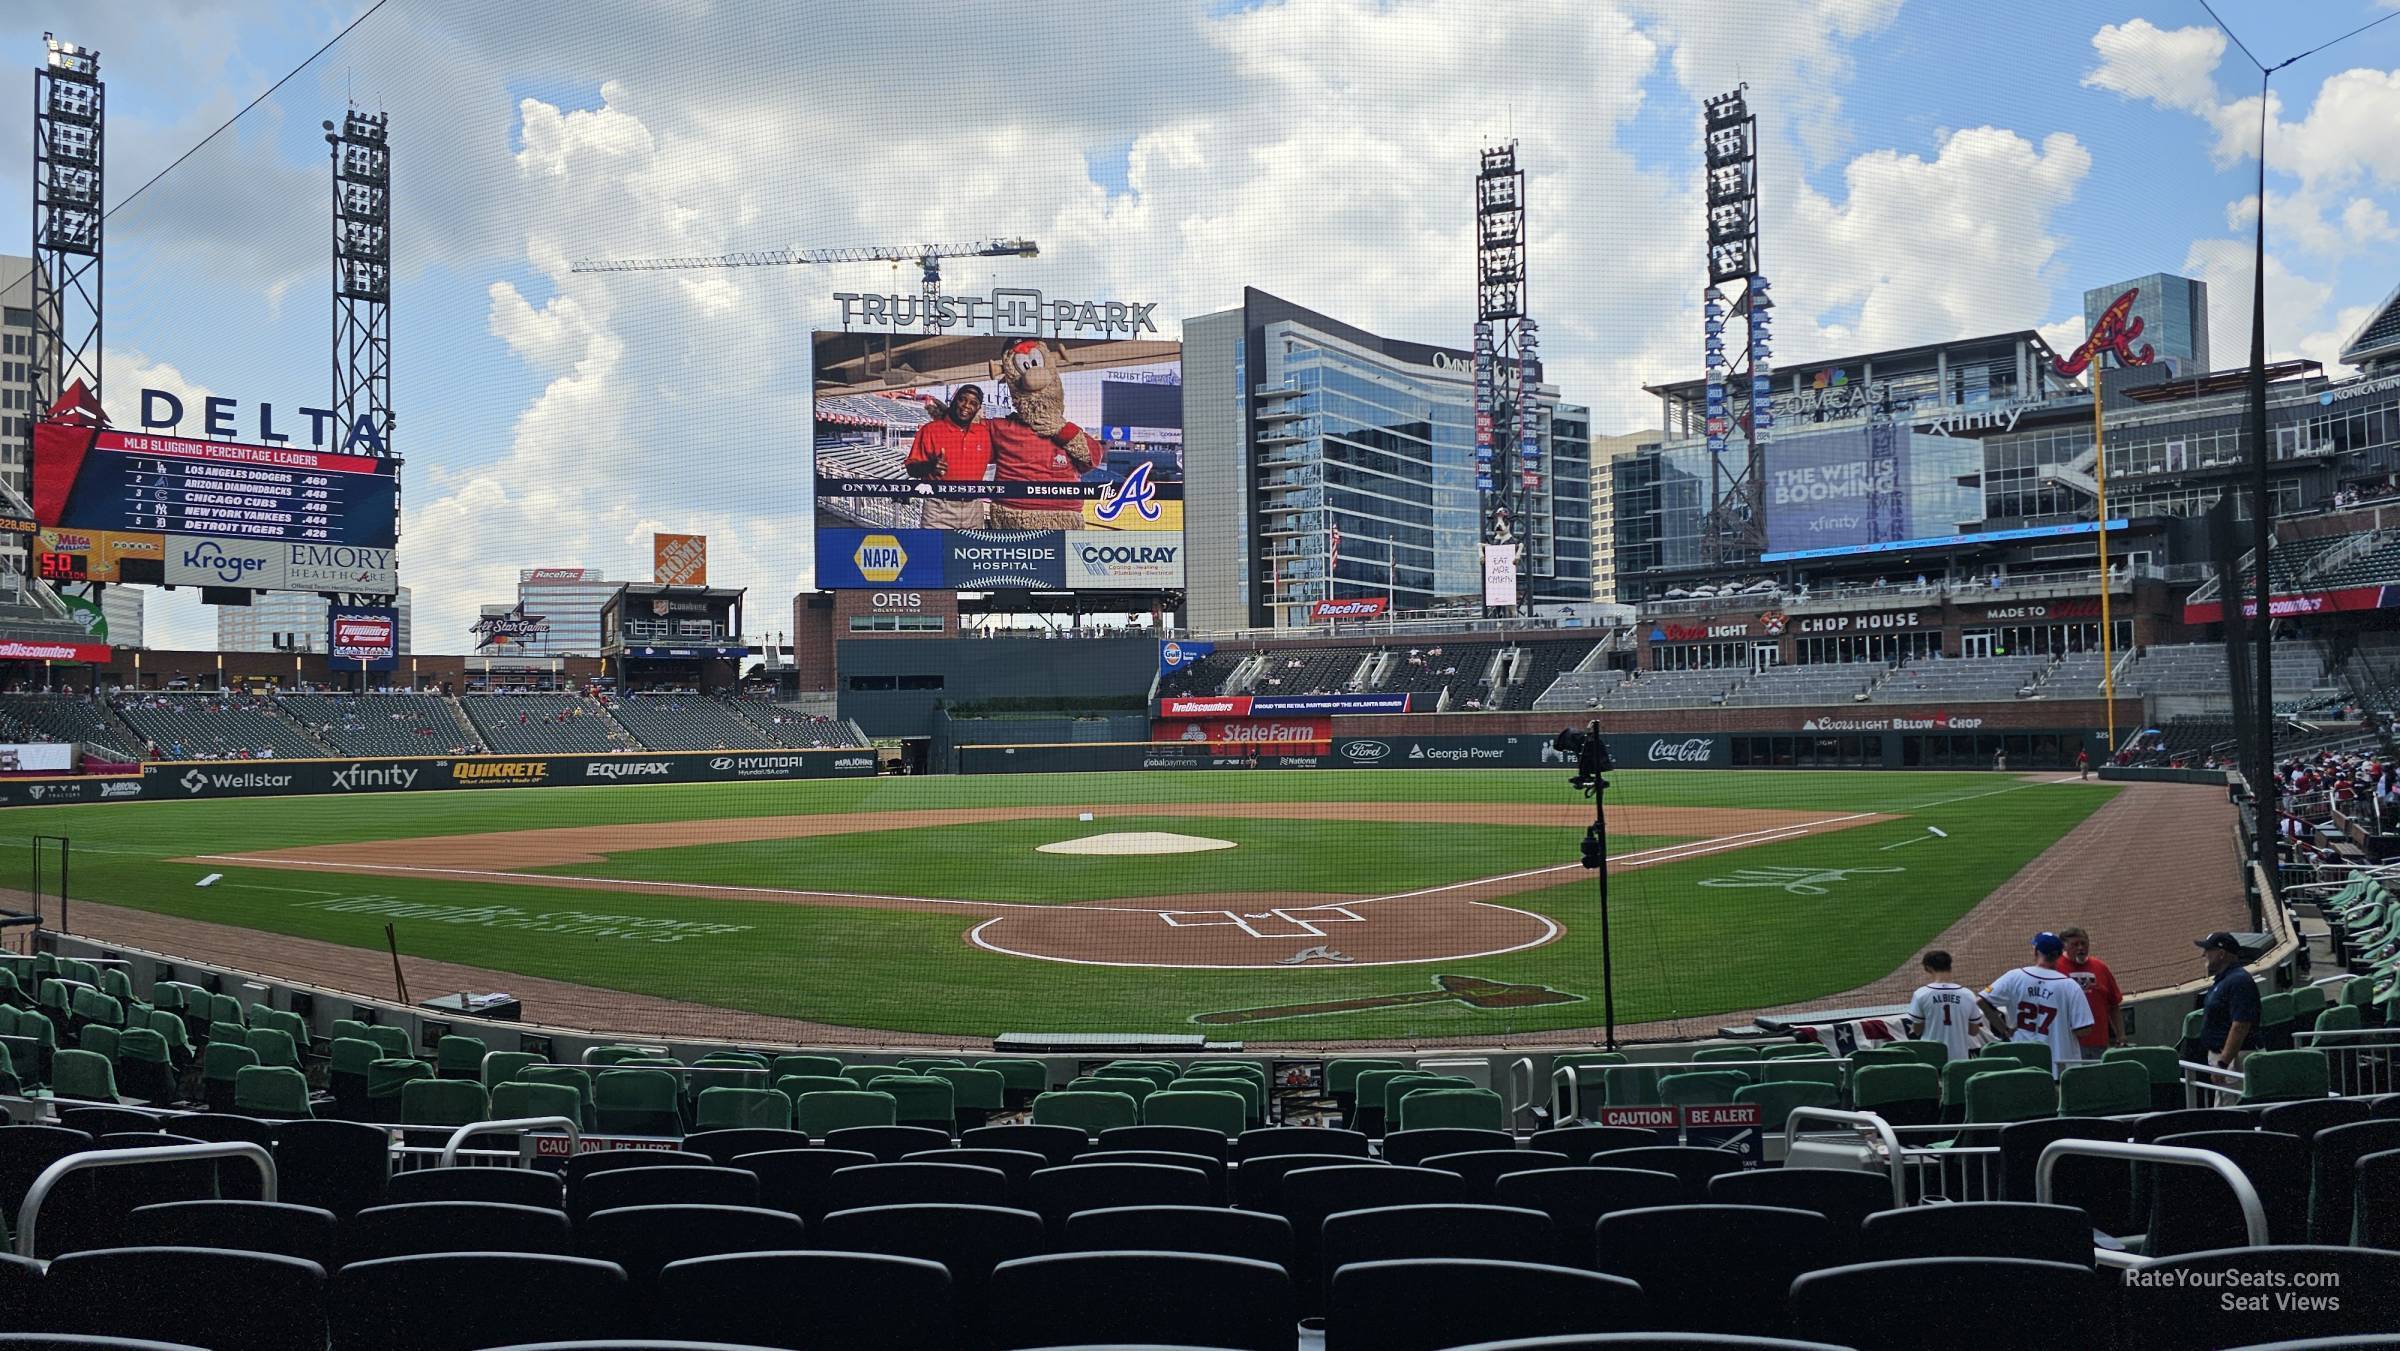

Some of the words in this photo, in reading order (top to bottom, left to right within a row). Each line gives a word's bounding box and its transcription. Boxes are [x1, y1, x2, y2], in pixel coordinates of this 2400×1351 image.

[833, 292, 983, 328] TRUIST
[1053, 299, 1158, 333] PARK
[2334, 384, 2375, 401] KONICA
[141, 388, 385, 455] DELTA
[1928, 404, 2026, 438] xfinity
[124, 437, 147, 450] MLB
[151, 440, 202, 456] SLUGGING
[206, 445, 272, 462] PERCENTAGE
[274, 450, 318, 466] LEADERS
[185, 465, 199, 475] LOS
[199, 467, 248, 479] ANGELES
[248, 471, 292, 483] DODGERS
[302, 477, 328, 486] .460
[1775, 467, 1816, 486] THE
[1822, 461, 1868, 480] WIFI
[1874, 459, 1895, 476] IS
[136, 475, 142, 483] 2
[185, 479, 223, 491] ARIZONA
[224, 482, 292, 496] DIAMONDBACKS
[302, 490, 328, 499] .448
[842, 483, 912, 492] ONWARD
[938, 485, 1006, 494] RESERVE
[1027, 486, 1080, 495] DESIGNED
[1083, 486, 1095, 495] IN
[1775, 476, 1895, 505] BOOMING
[136, 489, 142, 497] 3
[185, 493, 242, 506] CHICAGO
[244, 496, 278, 508] CUBS
[302, 503, 328, 512] .448
[136, 503, 142, 511] 4
[185, 507, 210, 516] NEW
[211, 508, 241, 519] YORK
[243, 511, 292, 523] YANKEES
[302, 516, 328, 525] .444
[185, 520, 239, 533] DETROIT
[240, 524, 284, 535] TIGERS
[302, 529, 328, 538] .426
[1809, 515, 1860, 532] xfinity
[58, 533, 91, 545] MEGA
[291, 544, 391, 570] EMORY
[659, 539, 681, 558] THE
[954, 548, 1055, 560] NORTHSIDE
[1082, 546, 1178, 564] COOLRAY
[42, 553, 72, 571] 50
[184, 541, 266, 583] Kroger
[655, 535, 706, 584] HOME
[863, 548, 900, 569] NAPA
[972, 562, 1037, 570] HOSPITAL
[291, 568, 386, 583] HEALTHCARE
[536, 570, 580, 578] RaceTrac
[675, 554, 705, 585] DEPOT
[872, 592, 921, 607] ORIS
[1317, 602, 1378, 615] RaceTrac
[1987, 607, 2025, 619] MADE
[2028, 606, 2046, 616] TO
[1801, 616, 1849, 632] CHOP
[1856, 612, 1919, 629] HOUSE
[1708, 624, 1748, 638] LIGHT
[1165, 650, 1181, 658] Gulf
[1171, 702, 1234, 712] TireDiscounters
[1818, 716, 1854, 730] Coors
[1855, 719, 1889, 730] LIGHT
[1893, 718, 1934, 729] BELOW
[1949, 717, 1983, 729] CHOP
[1350, 742, 1382, 757] Ford
[1427, 748, 1469, 760] Georgia
[1471, 747, 1504, 758] Power
[1648, 738, 1714, 762] Coca-Cola
[738, 756, 803, 769] HYUNDAI
[835, 758, 852, 767] PAPA
[851, 758, 873, 766] JOHNS
[1288, 757, 1318, 765] National
[144, 766, 158, 774] 375
[331, 763, 419, 790] xfinity
[453, 762, 549, 778] QUIKRETE
[586, 762, 672, 779] EQUIFAX
[48, 784, 81, 792] TYM
[212, 773, 292, 788] Wellstar
[483, 918, 702, 943] CASINOS
[1932, 993, 1961, 1005] ALBIES
[2027, 986, 2054, 1001] RILEY
[1943, 1004, 1953, 1026] 1
[2016, 1001, 2058, 1036] 27
[1608, 1110, 1673, 1125] CAUTION
[1691, 1109, 1710, 1123] BE
[1714, 1108, 1755, 1123] ALERT
[539, 1138, 600, 1154] CAUON
